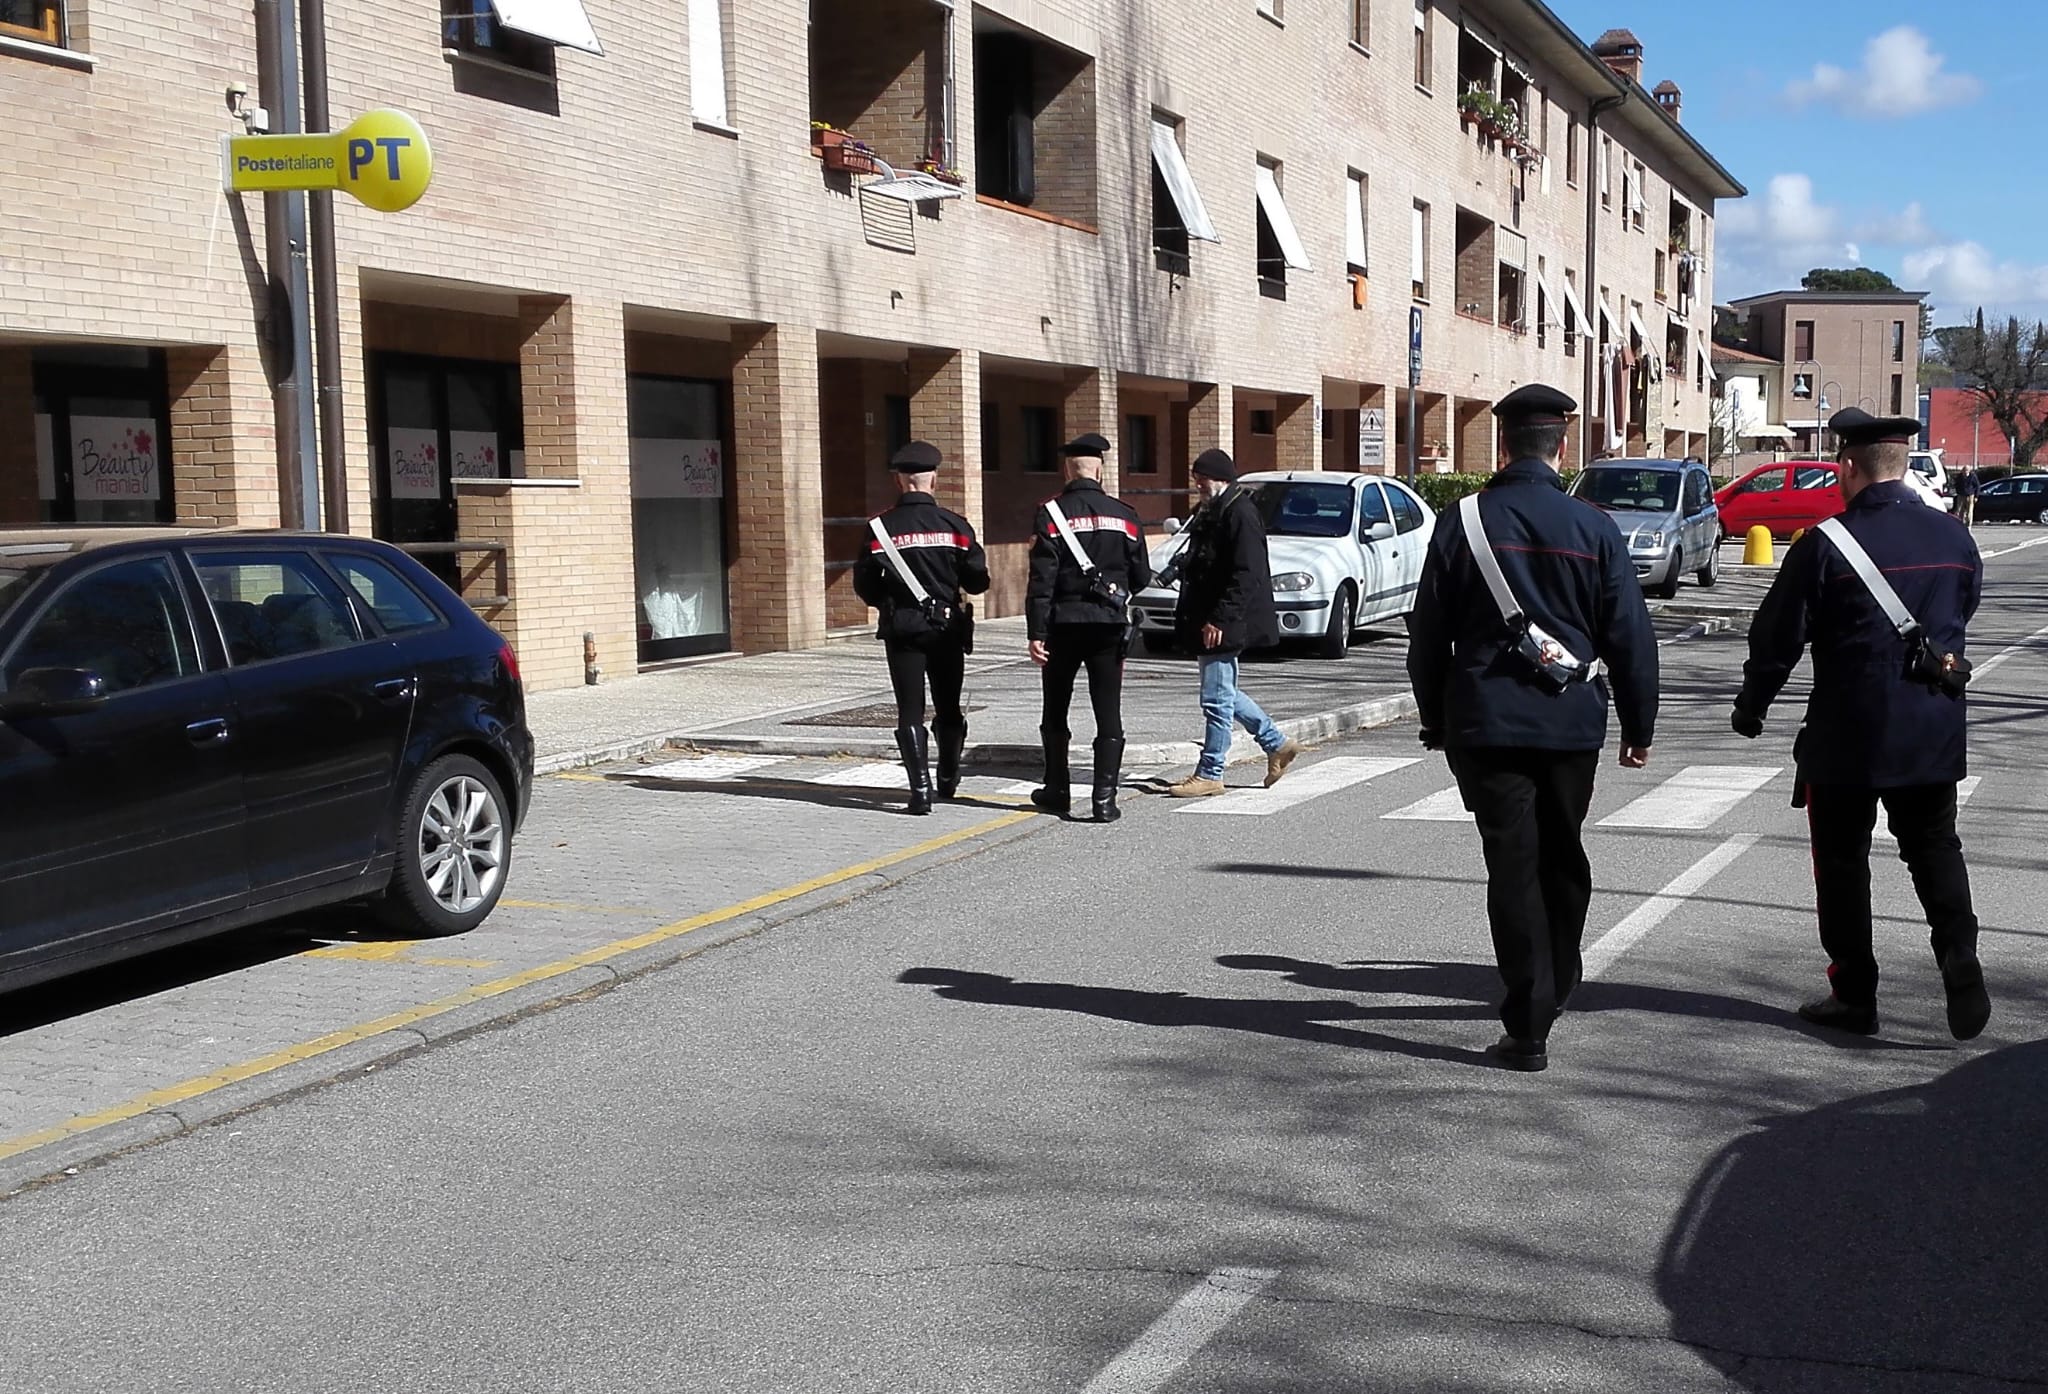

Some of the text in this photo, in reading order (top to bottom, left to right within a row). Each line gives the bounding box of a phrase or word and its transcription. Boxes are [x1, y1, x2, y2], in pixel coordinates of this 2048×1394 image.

[348, 137, 411, 181] PT
[1413, 311, 1420, 343] P
[78, 437, 154, 494] Beauty
[394, 449, 437, 482] Beauty
[95, 477, 141, 495] mania
[891, 532, 953, 547] CARABINIERI
